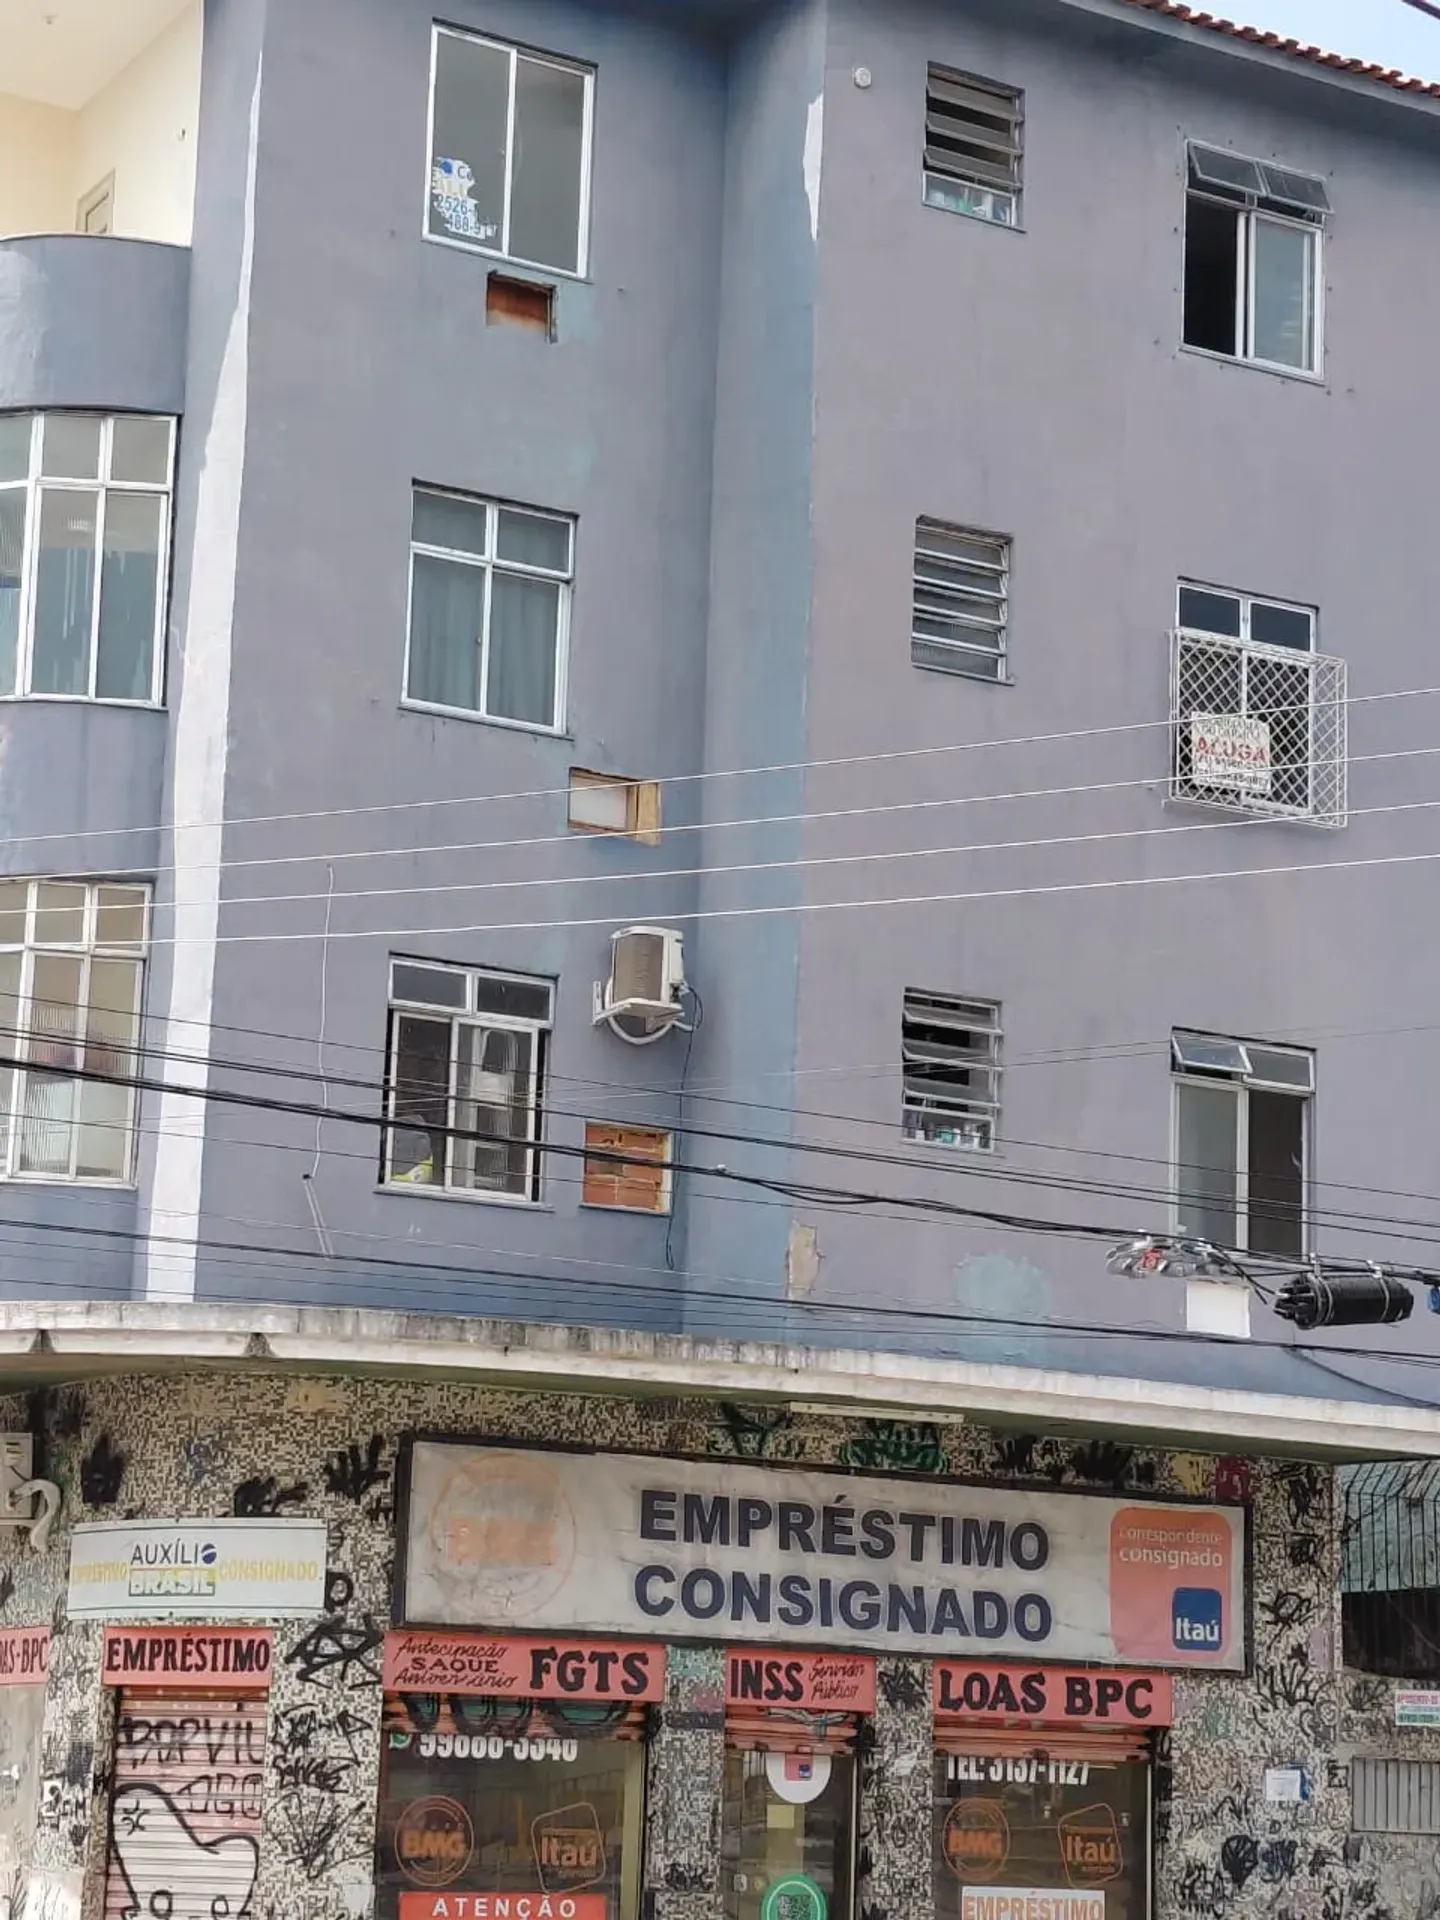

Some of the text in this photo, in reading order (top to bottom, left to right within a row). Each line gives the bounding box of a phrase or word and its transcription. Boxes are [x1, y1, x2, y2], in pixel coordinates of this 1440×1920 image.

[640, 1490, 1049, 1571] EMPRÉSTIMO
[1120, 1546, 1223, 1569] consignado
[634, 1564, 1053, 1642] CONSIGNADO
[1175, 1617, 1219, 1641] Itaú
[105, 1633, 270, 1673] EMPRÉSTIMO
[411, 1657, 499, 1674] SAQUE
[529, 1646, 649, 1695] FGTS
[730, 1658, 804, 1702] INSS
[938, 1669, 1154, 1719] LOAS BPC
[541, 1835, 598, 1867] Itaú
[1066, 1836, 1116, 1863] Itaú
[432, 1895, 576, 1920] ATENÇÃO
